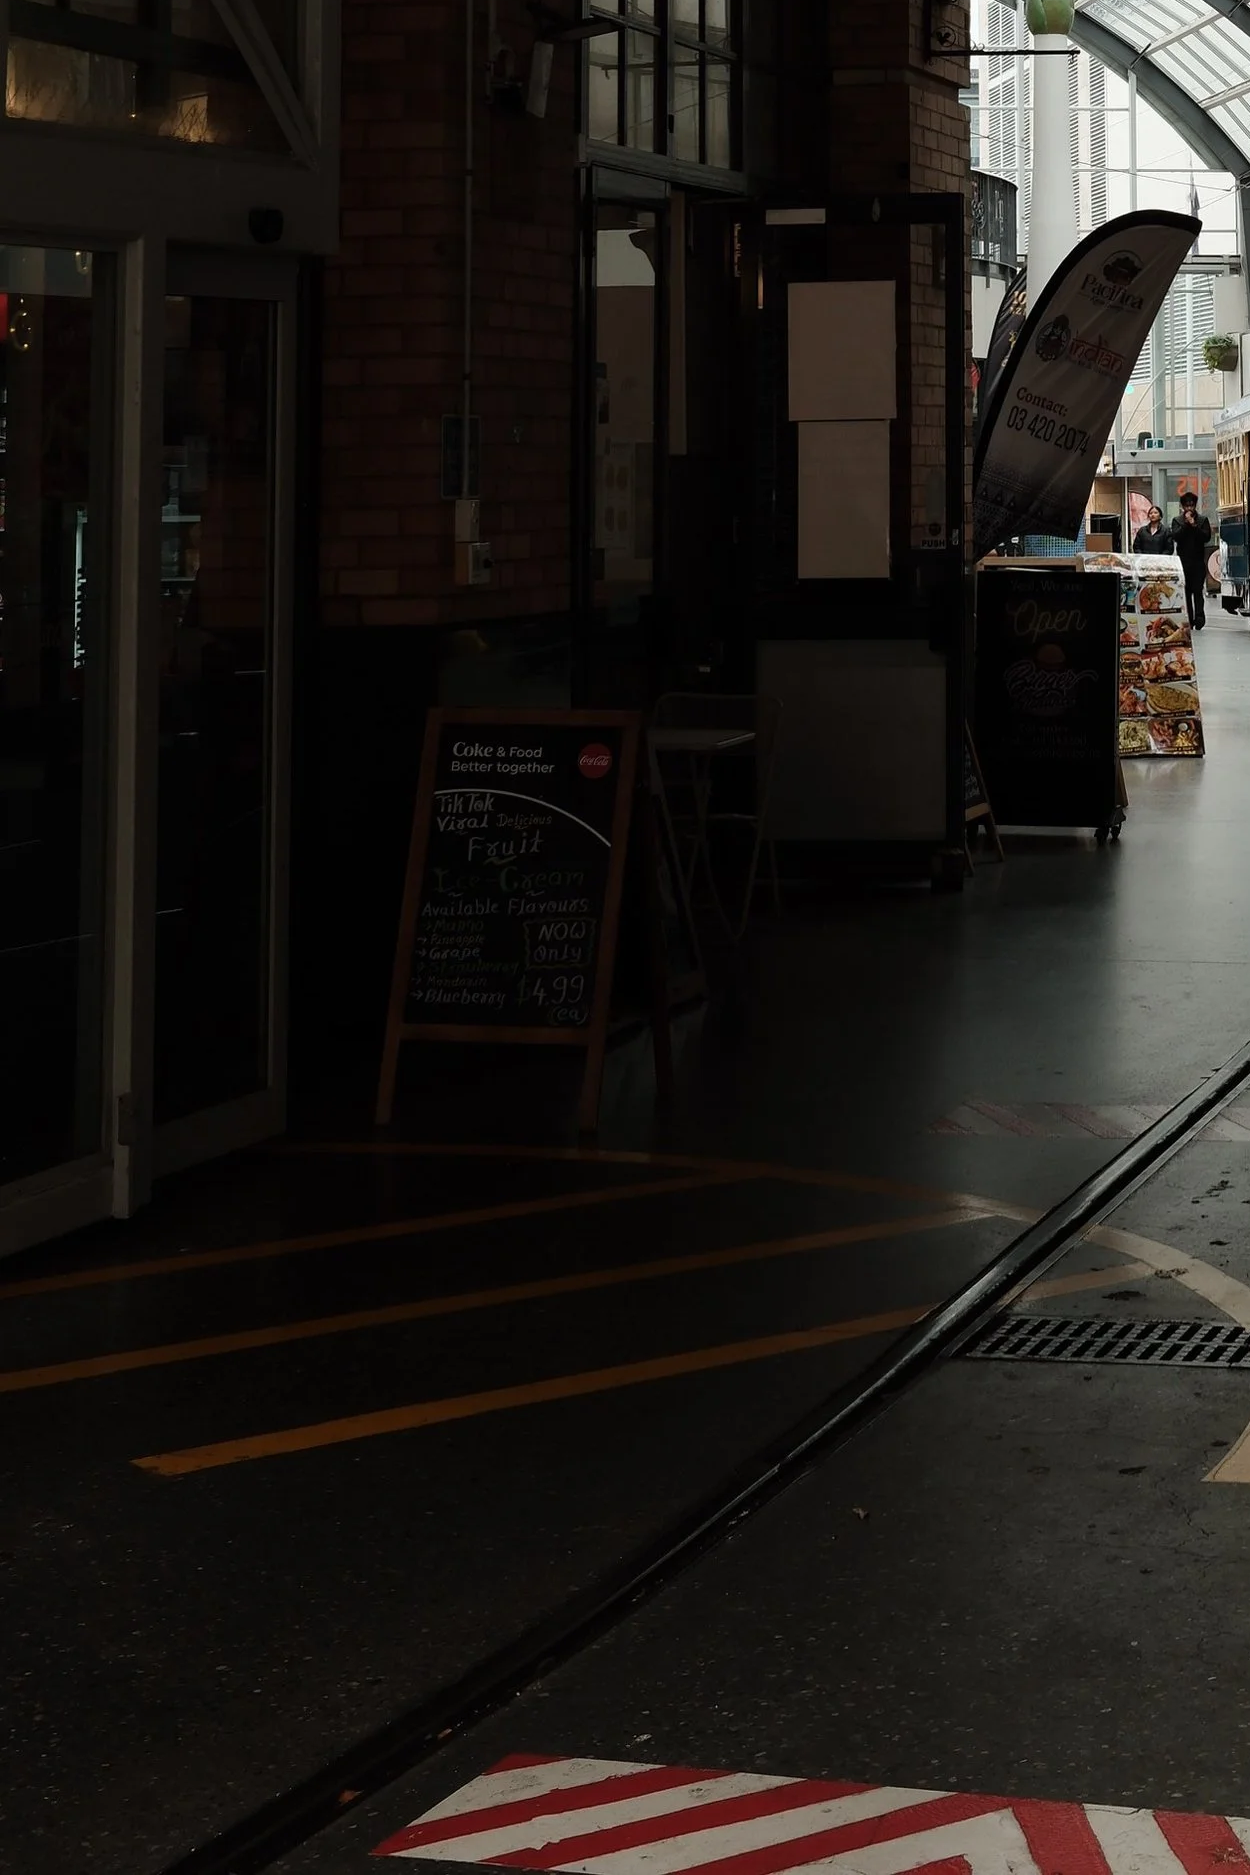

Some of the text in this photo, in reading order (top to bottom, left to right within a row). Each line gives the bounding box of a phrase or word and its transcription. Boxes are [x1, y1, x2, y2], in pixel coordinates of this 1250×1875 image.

[1016, 387, 1069, 417] Contact:
[1006, 405, 1091, 456] 03 420 2074
[921, 539, 945, 547] PUSH
[1005, 599, 1089, 644] Open
[452, 741, 494, 758] Coke
[496, 748, 506, 758] &
[509, 746, 543, 758] Food
[451, 760, 556, 776] Better together
[436, 813, 553, 833] Viral Delicious
[468, 829, 545, 862] Fruit
[421, 897, 590, 917] Available Flavours
[429, 933, 487, 946] Pineapple
[538, 921, 587, 942] NOW
[429, 946, 481, 961] Grape
[533, 943, 582, 963] Only
[426, 976, 489, 988] Mandarin
[424, 989, 507, 1007] Blueberry
